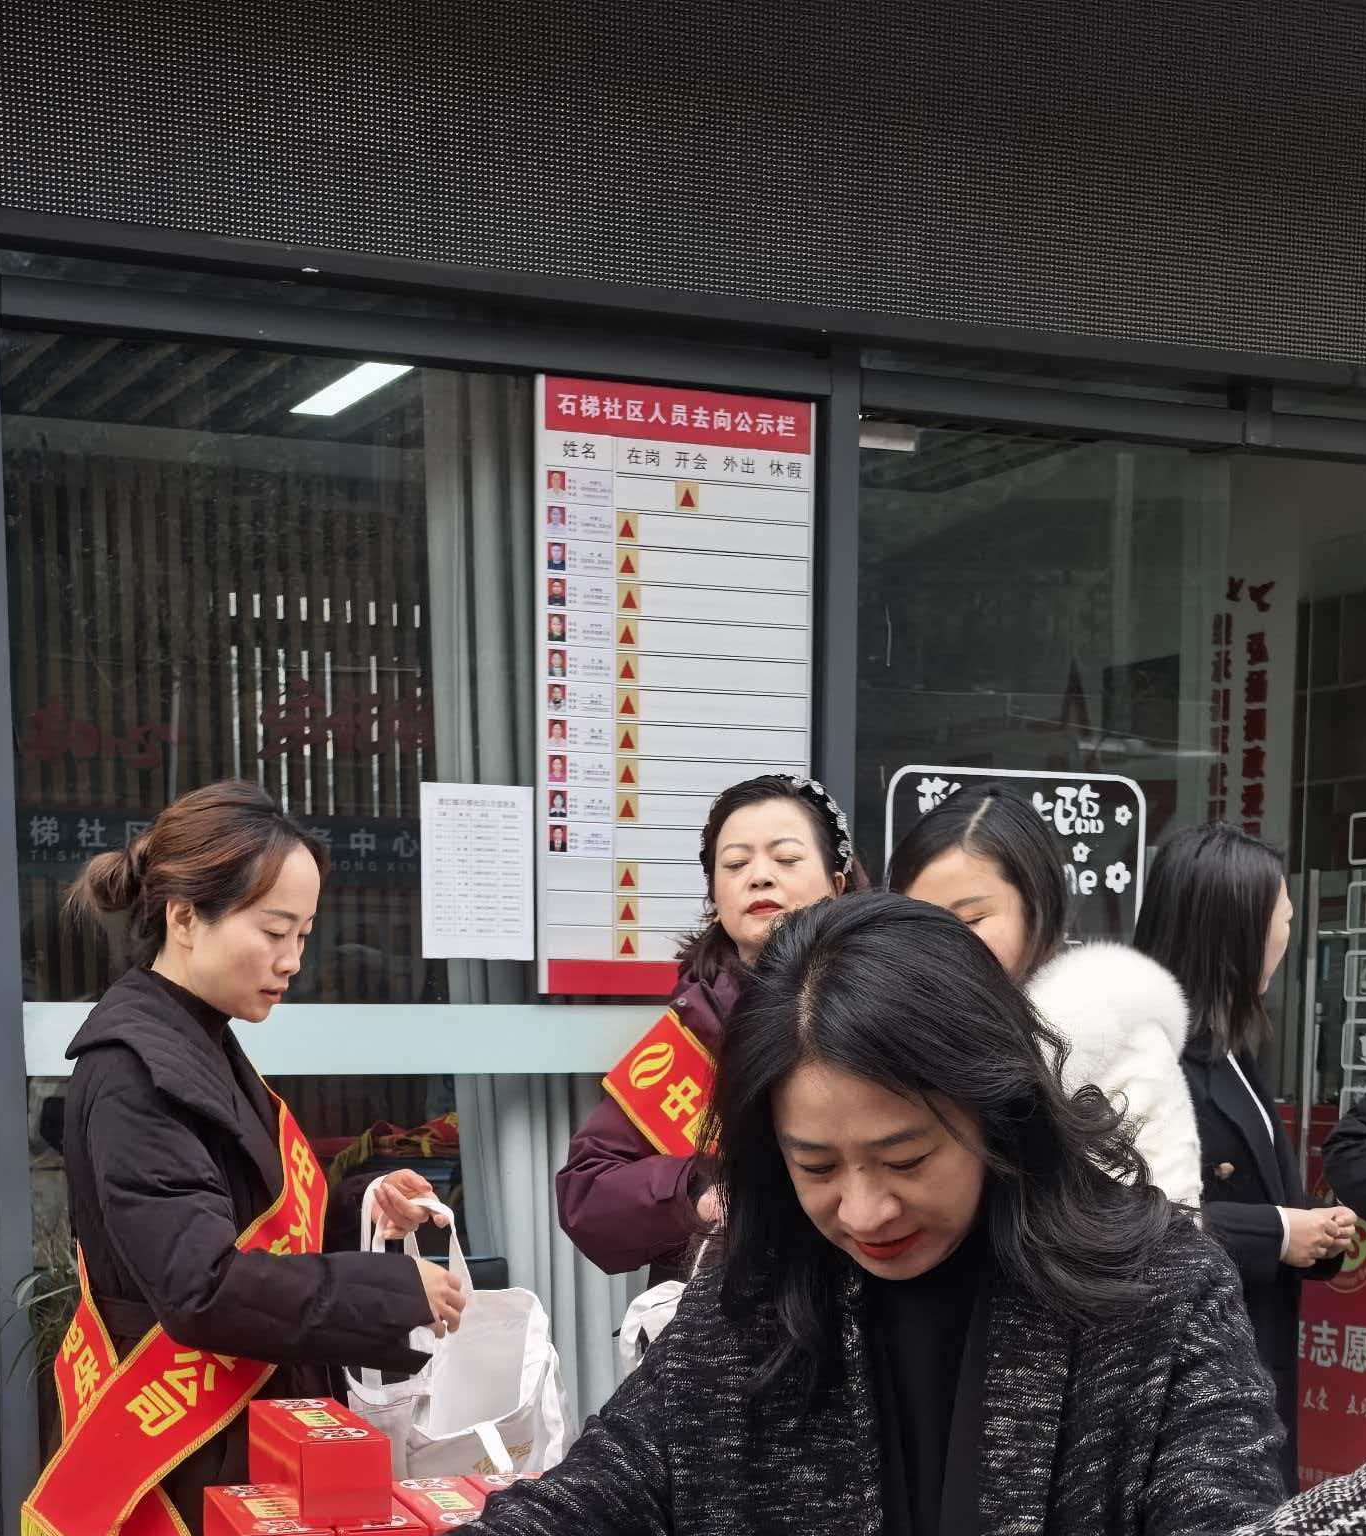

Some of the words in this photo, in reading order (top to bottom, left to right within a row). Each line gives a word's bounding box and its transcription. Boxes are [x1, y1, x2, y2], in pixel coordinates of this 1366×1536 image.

[558, 393, 796, 438] 石梯社区人员去向公示栏
[562, 441, 596, 460] 姓名
[626, 447, 660, 467] 在岗
[674, 452, 708, 471] 开会
[723, 456, 755, 474] 外出
[769, 461, 803, 480] 休假
